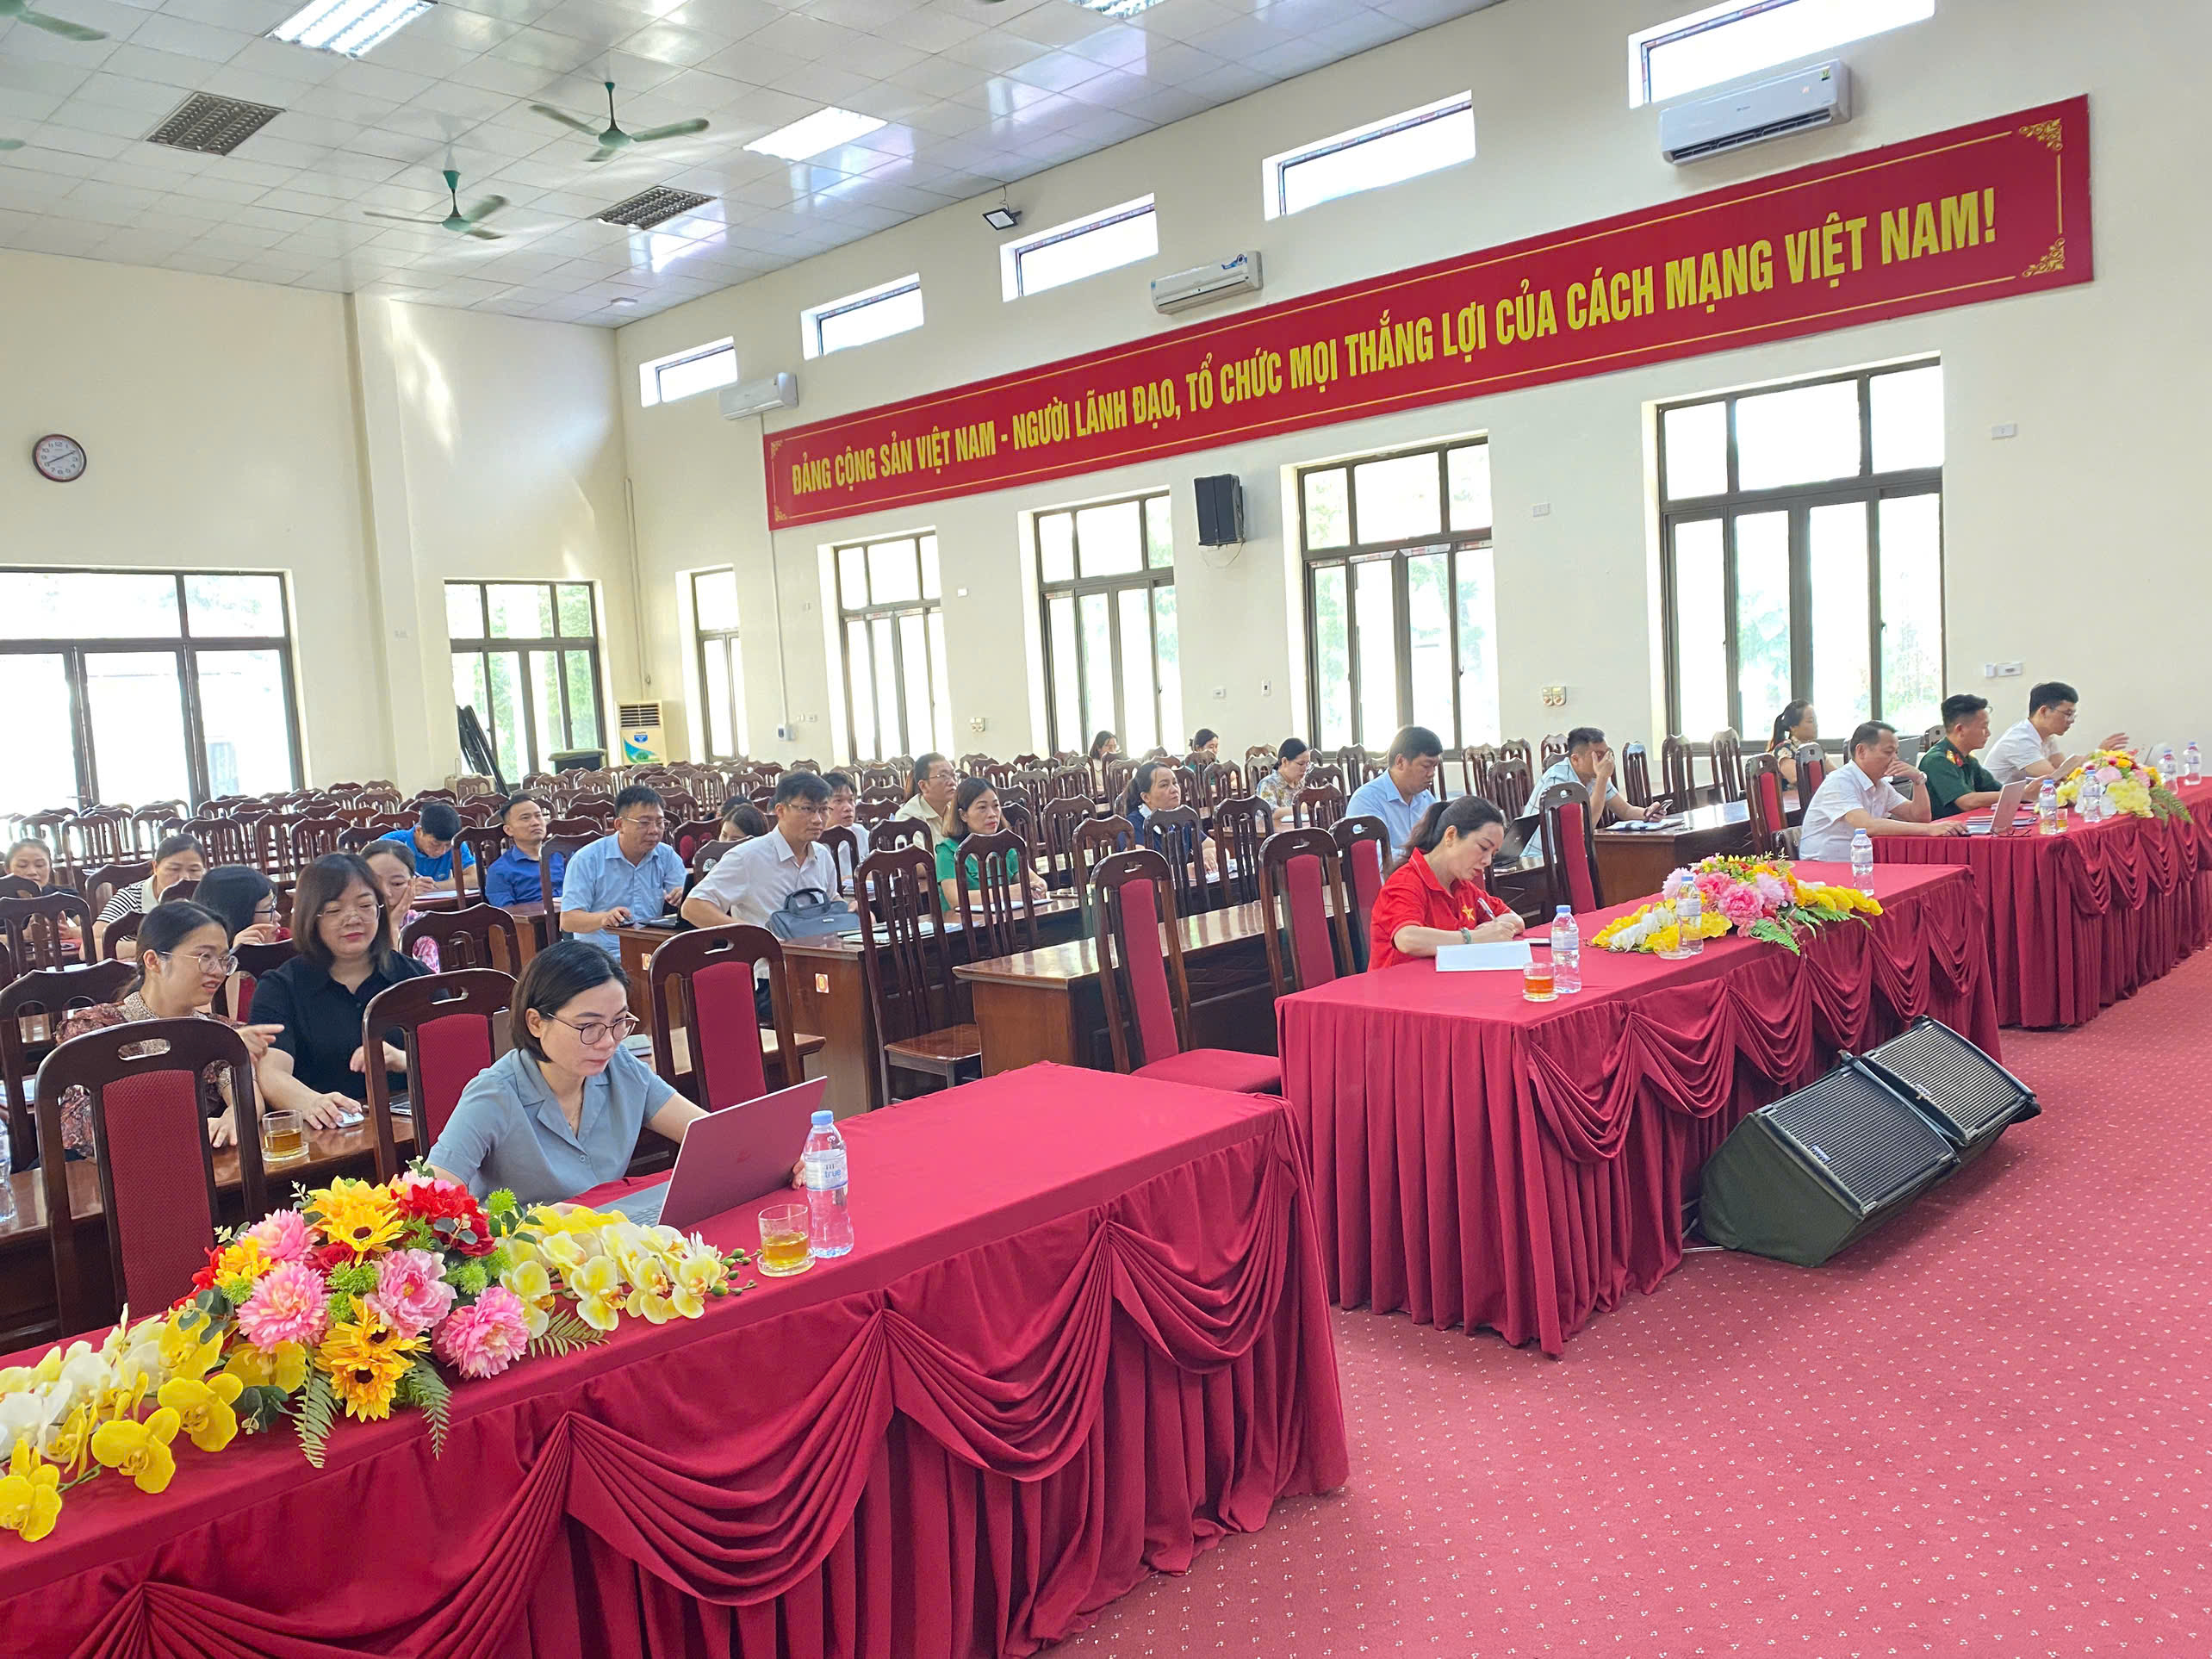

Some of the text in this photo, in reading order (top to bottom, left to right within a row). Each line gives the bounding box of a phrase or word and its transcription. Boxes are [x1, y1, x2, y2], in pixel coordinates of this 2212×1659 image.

[792, 451, 832, 496] ĐẢNG
[835, 445, 877, 492] CỘNG
[879, 431, 913, 477] SẢN
[916, 426, 951, 474] VIỆT
[954, 419, 997, 463] NAM
[1012, 396, 1071, 450] NGƯỜI
[1074, 389, 1128, 438] LÃNH
[1132, 378, 1181, 430] ĐẠO,
[1185, 351, 1214, 412] TỔ
[1220, 347, 1283, 405] CHỨC
[1289, 339, 1338, 394] MỌI
[1344, 308, 1434, 377] THẮNG
[1442, 301, 1487, 363] LỢI
[1495, 278, 1558, 345] CỦA
[1566, 266, 1655, 330] CÁCH
[1665, 239, 1774, 314] MẠNG
[1784, 212, 1867, 289] VIỆT
[1880, 187, 1996, 264] NAM!
[824, 1169, 842, 1178] true
